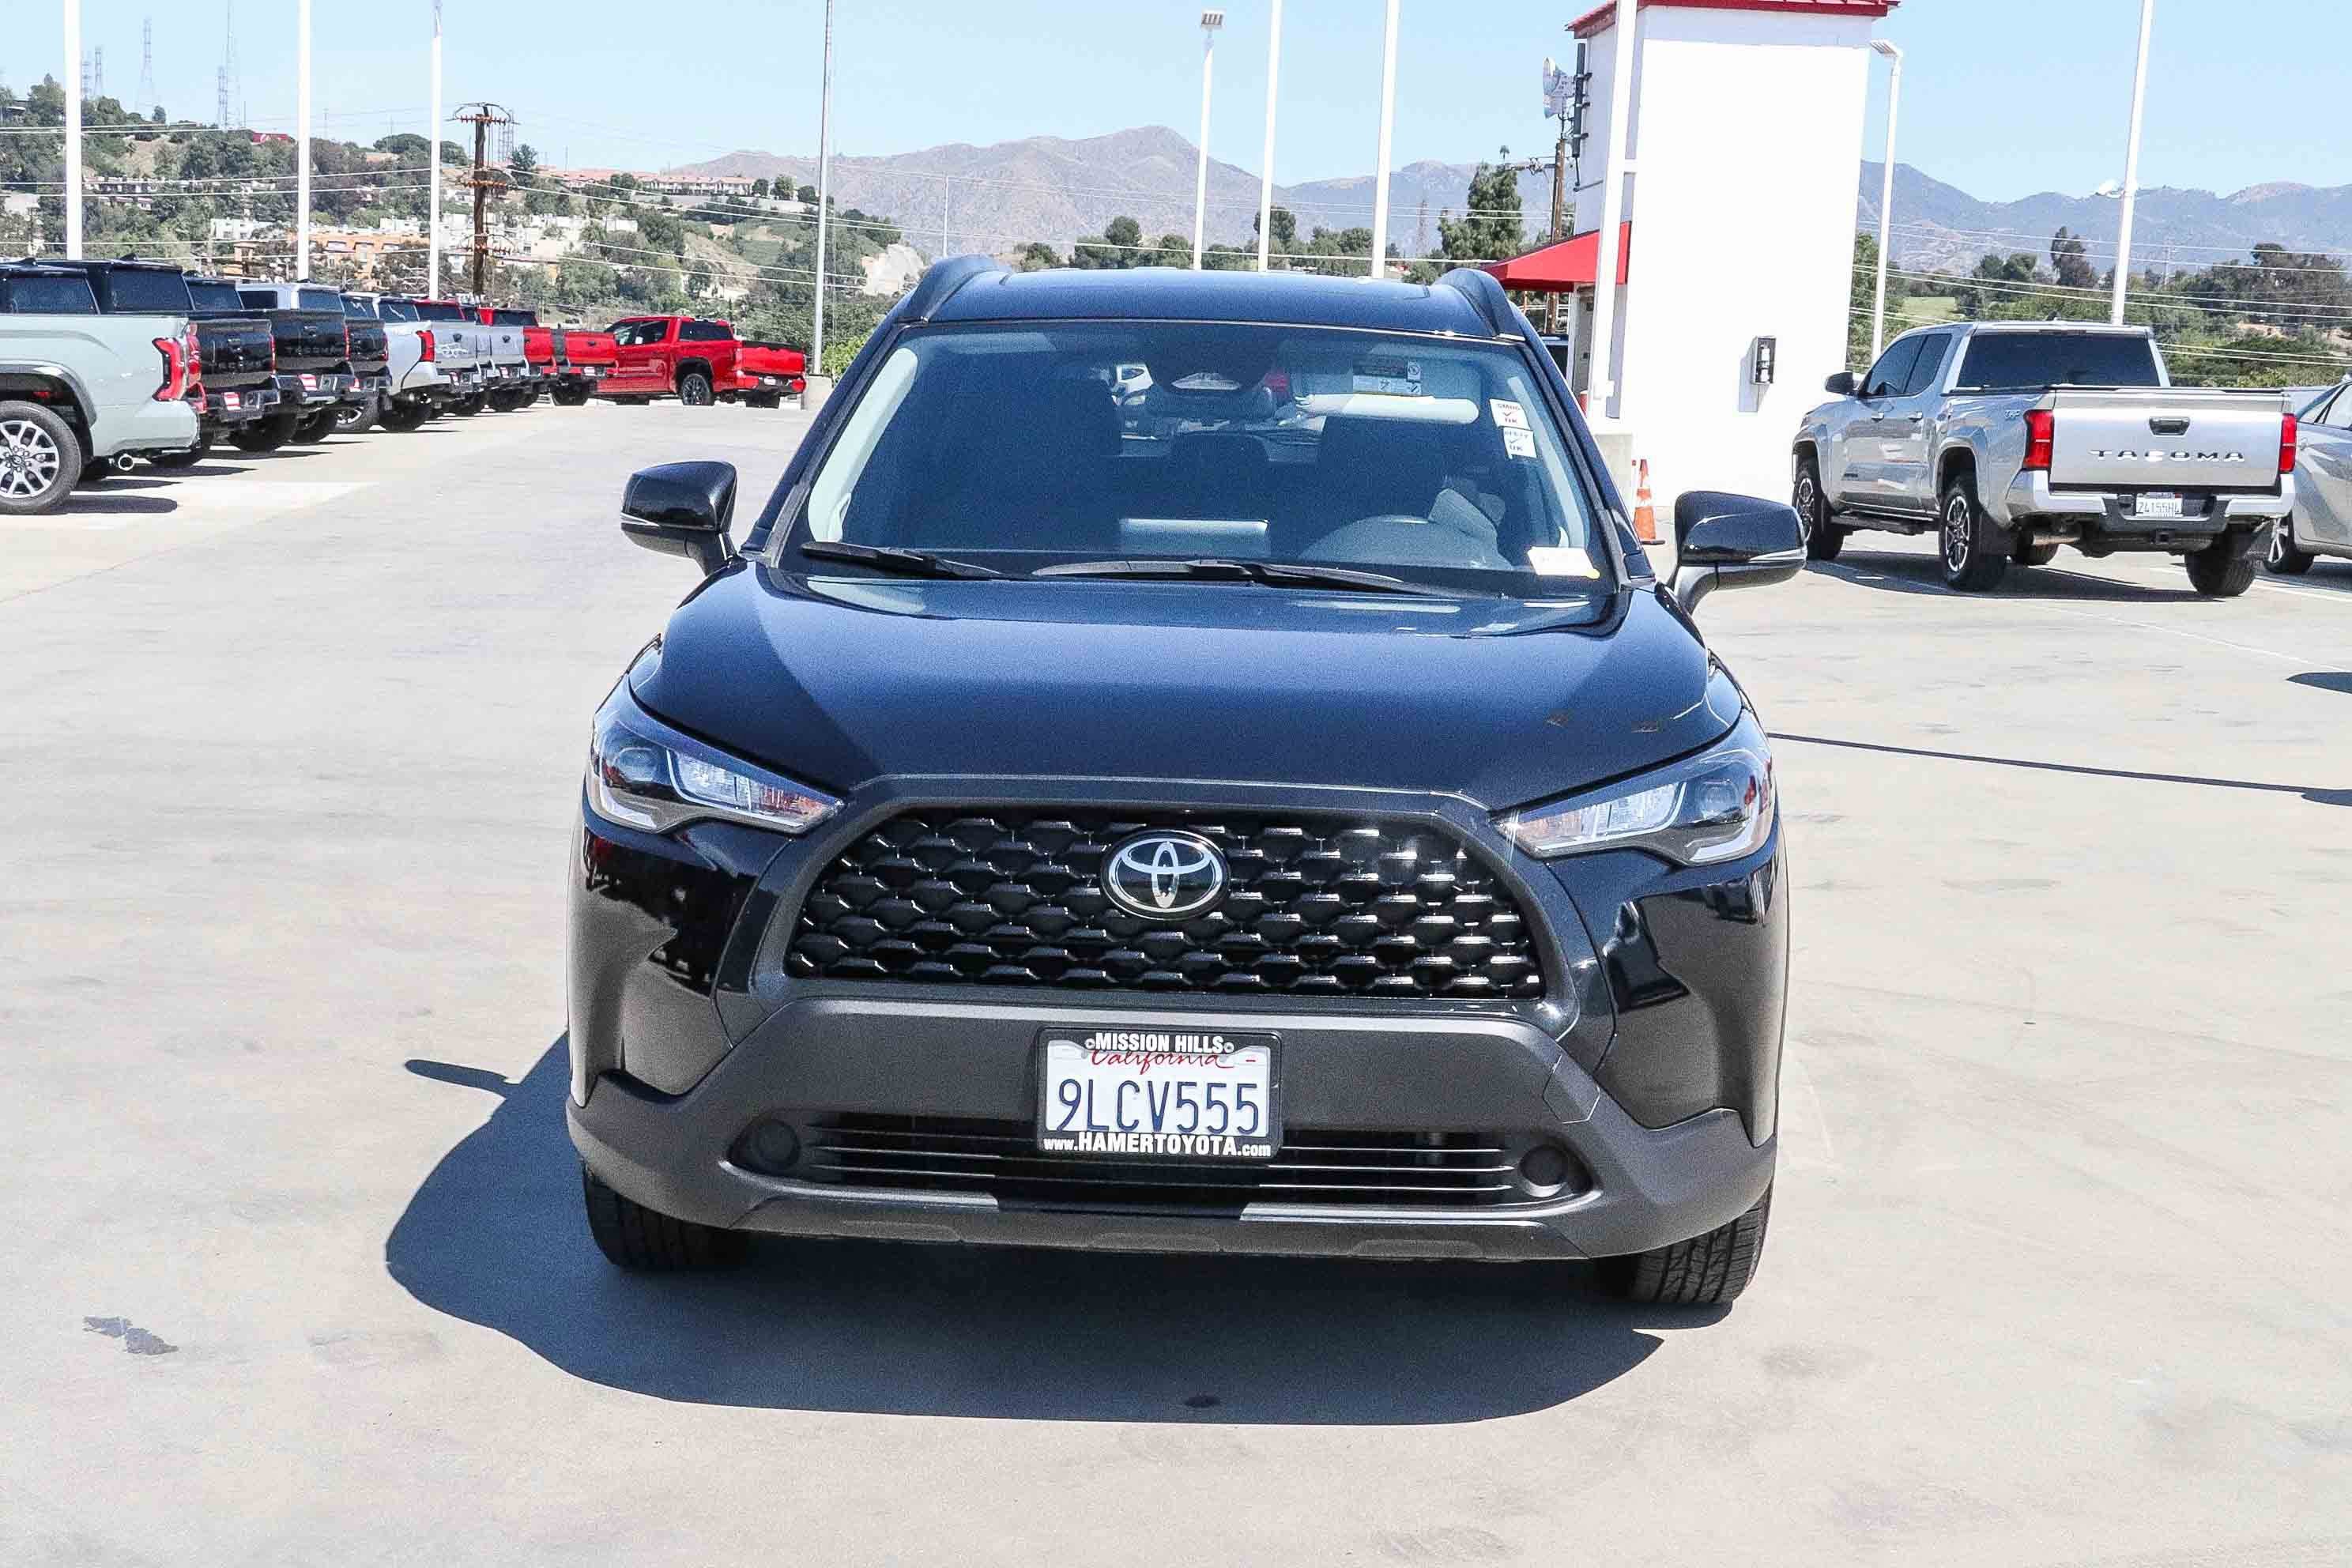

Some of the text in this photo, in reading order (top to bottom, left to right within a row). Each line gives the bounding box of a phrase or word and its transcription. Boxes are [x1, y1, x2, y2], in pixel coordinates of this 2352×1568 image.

[2087, 449, 2245, 462] TACOMA
[1094, 1032, 1224, 1054] MISSION HILLS
[1091, 1050, 1234, 1075] California
[1056, 1078, 1259, 1135] 9LCV555
[1042, 1131, 1272, 1157] www.HAMERTOYOTA.com
